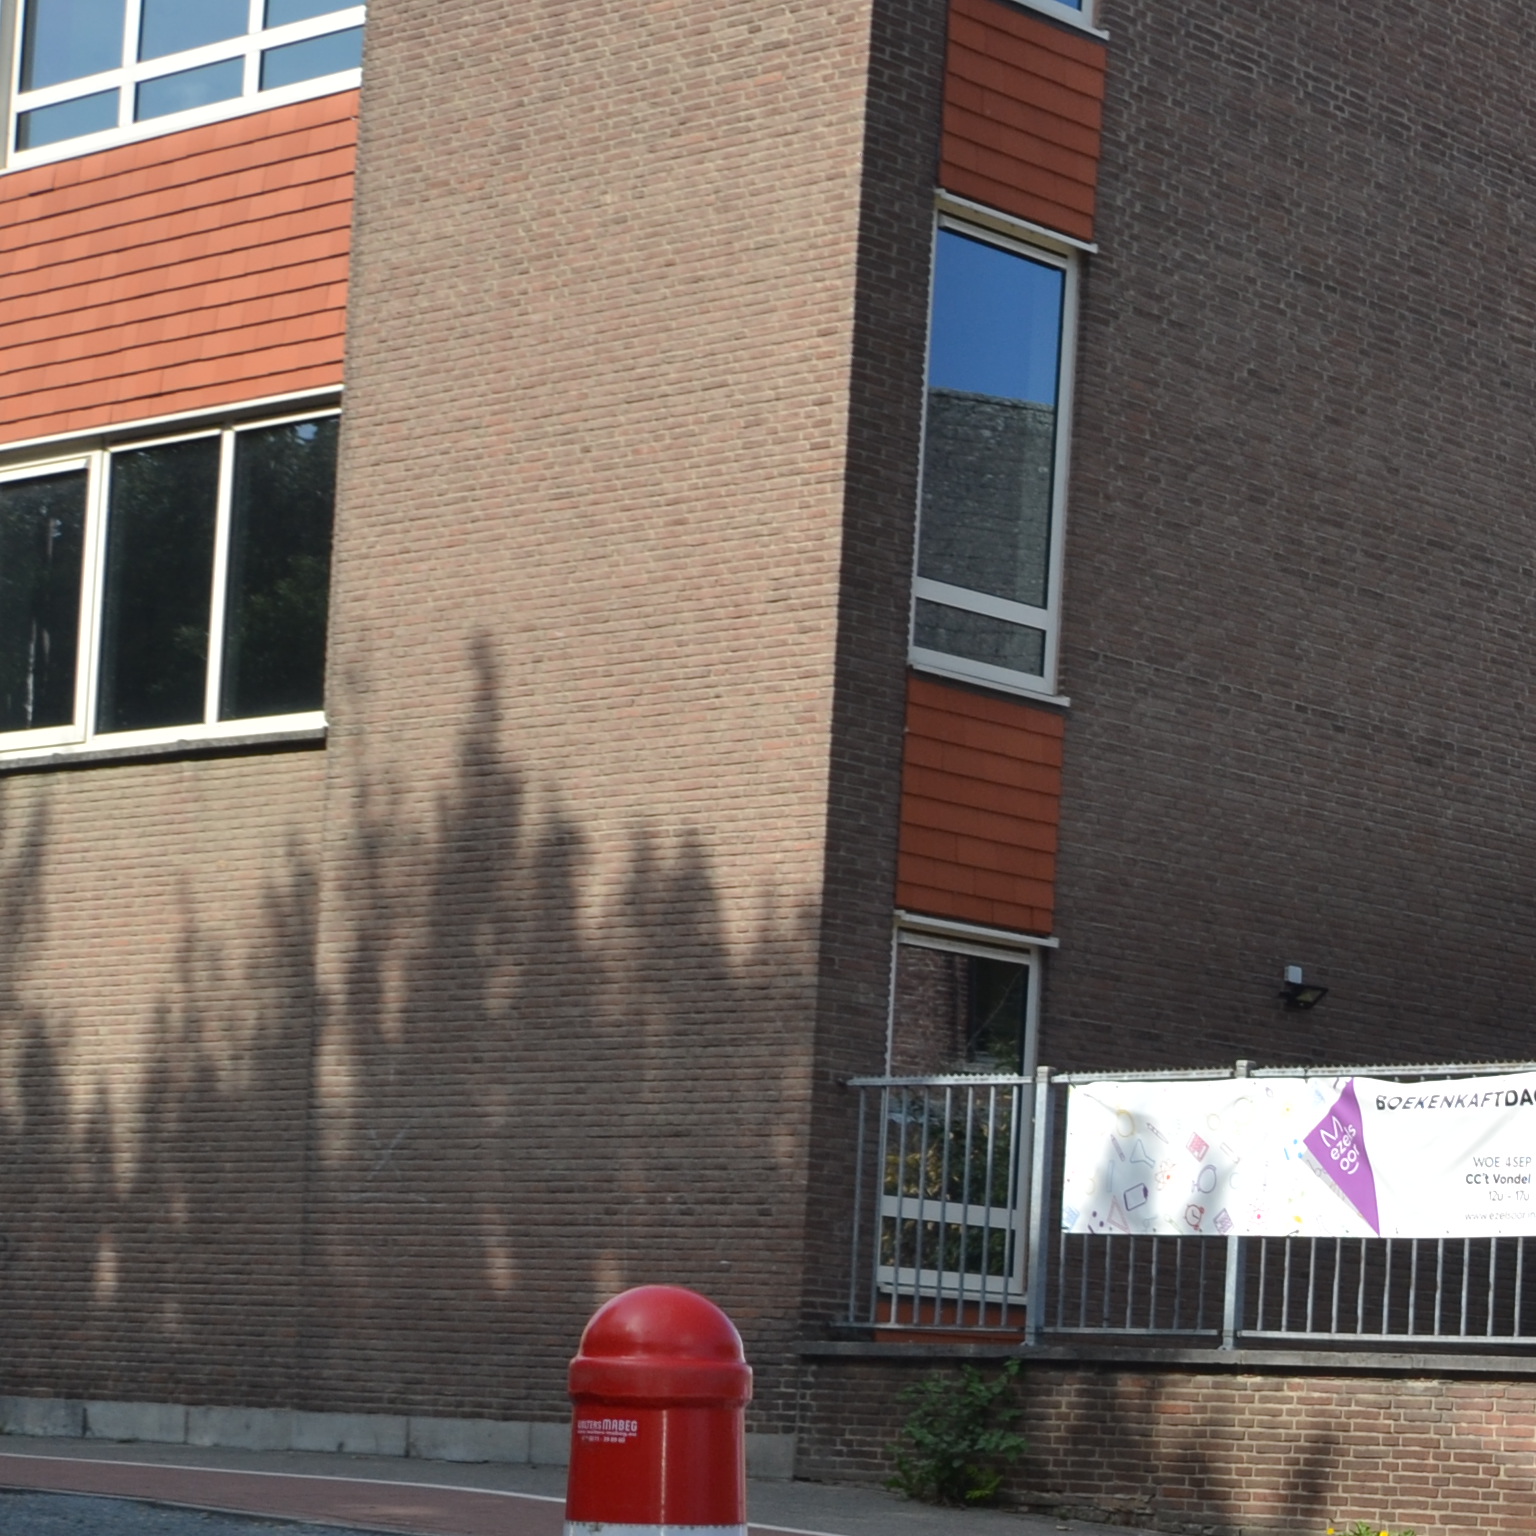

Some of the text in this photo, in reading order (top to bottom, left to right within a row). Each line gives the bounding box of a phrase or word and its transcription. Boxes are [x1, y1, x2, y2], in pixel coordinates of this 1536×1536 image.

[1473, 1156, 1500, 1167] WOE
[1493, 1173, 1531, 1185] Vondel
[602, 1418, 638, 1432] MABEG
